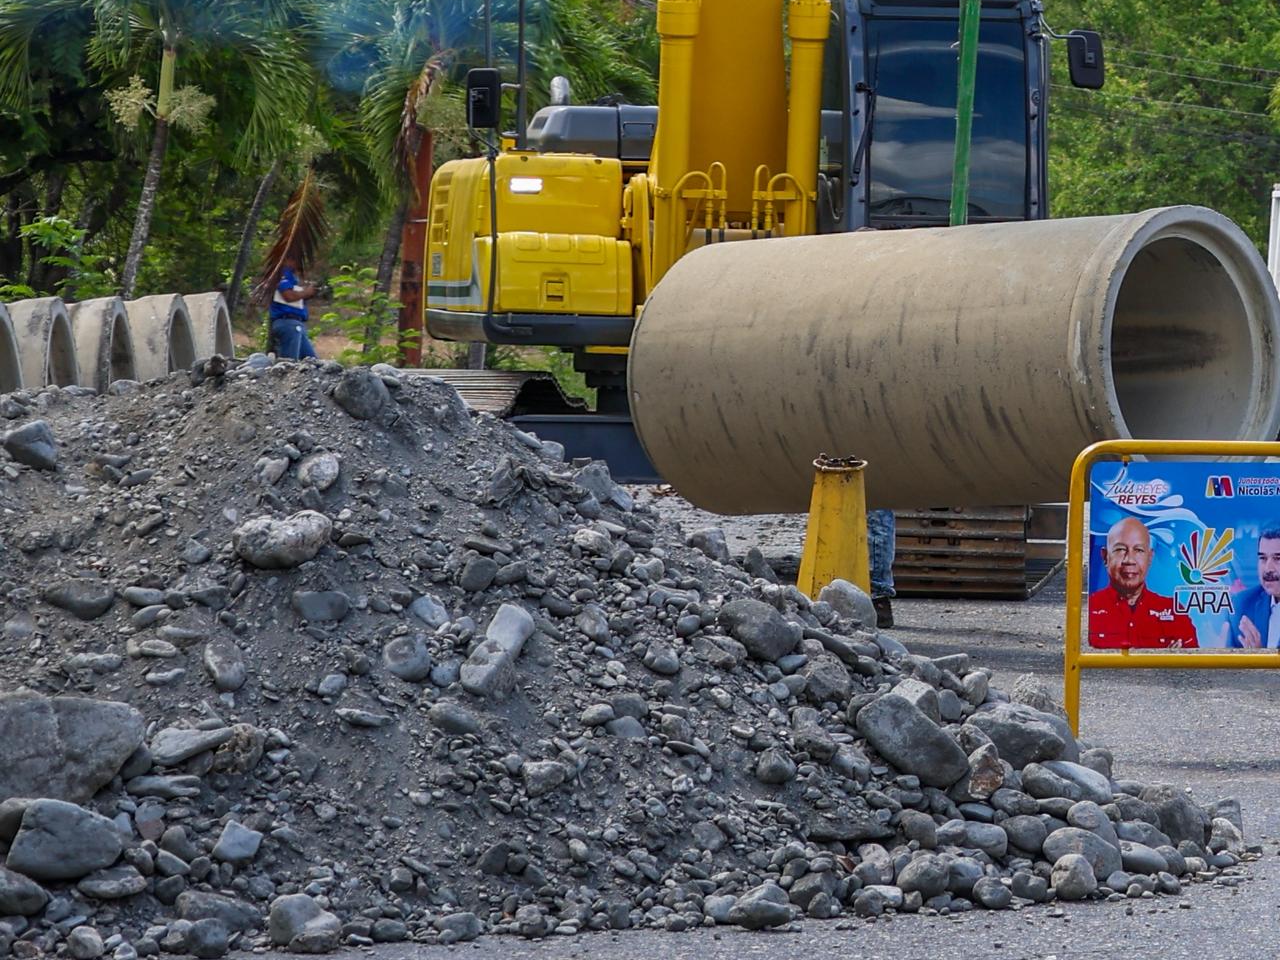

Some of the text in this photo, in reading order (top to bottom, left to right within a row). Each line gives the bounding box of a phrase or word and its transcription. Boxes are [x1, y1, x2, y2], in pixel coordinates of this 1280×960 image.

[1103, 468, 1169, 498] Luis REYES
[1238, 485, 1274, 496] Nicolás
[1118, 494, 1157, 505] REYES
[1174, 591, 1234, 614] LARA
